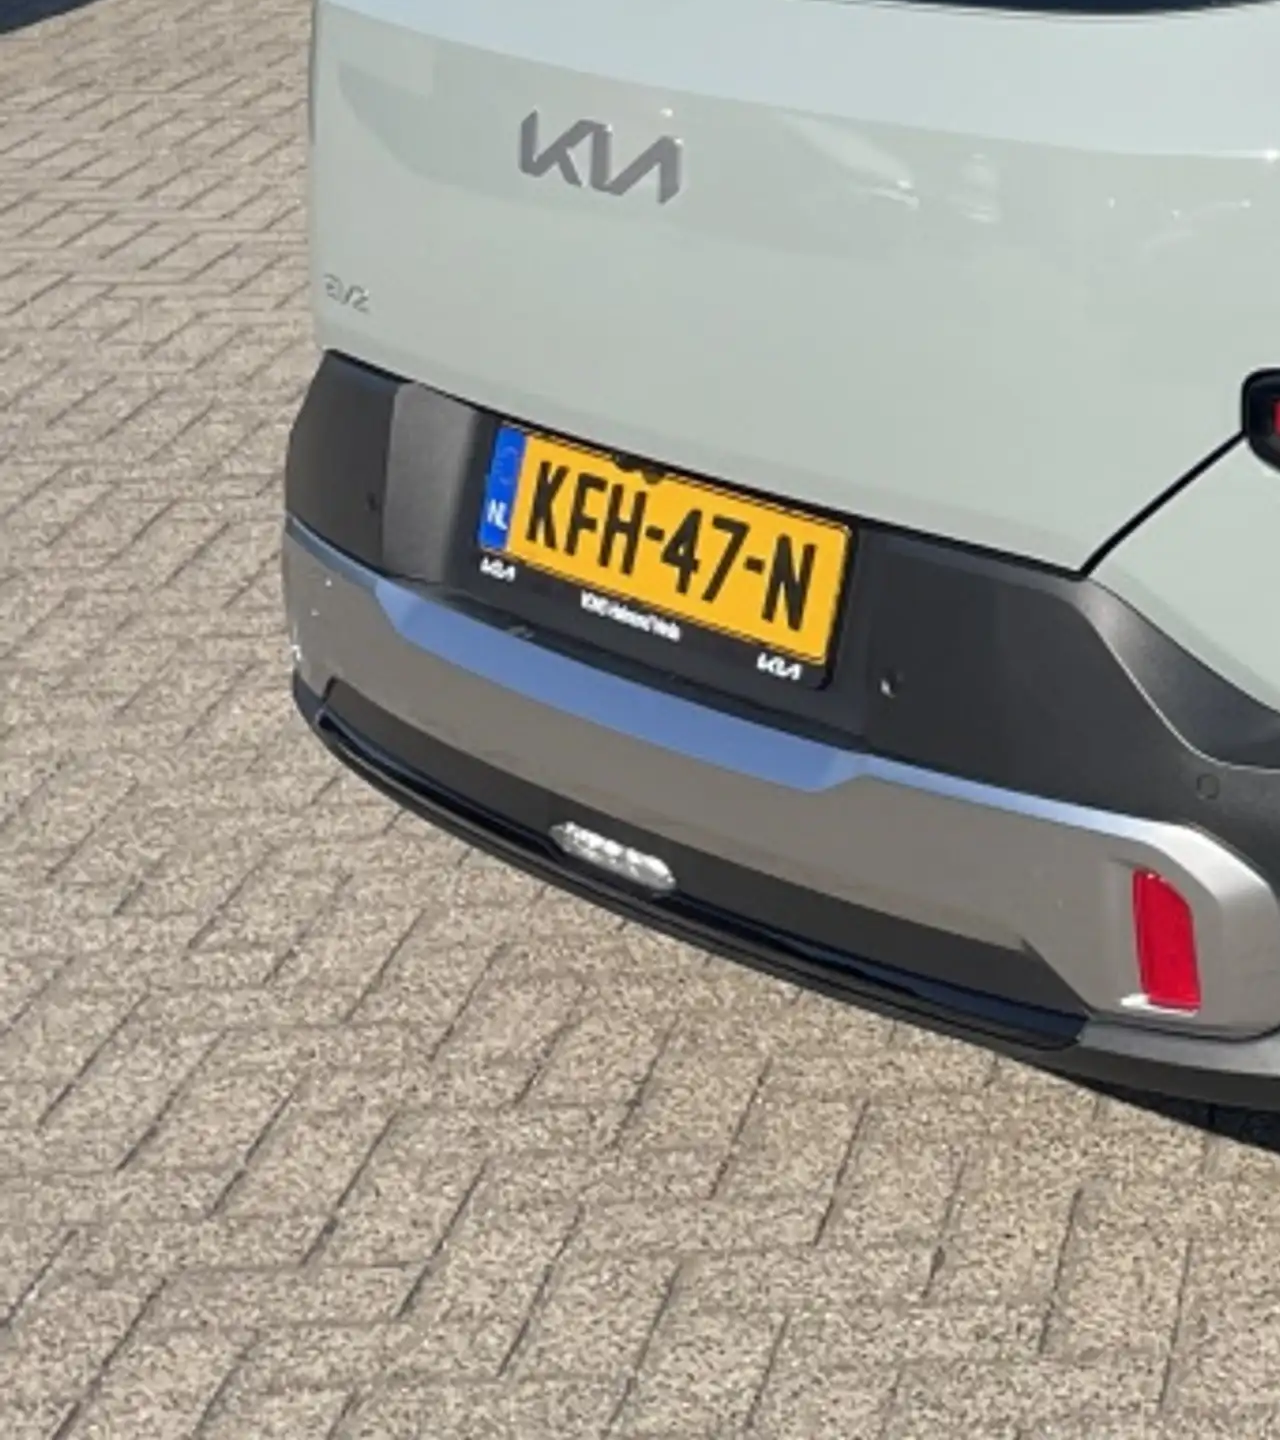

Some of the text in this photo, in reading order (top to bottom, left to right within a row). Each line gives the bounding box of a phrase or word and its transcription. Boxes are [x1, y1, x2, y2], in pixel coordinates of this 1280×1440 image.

[518, 106, 683, 205] KIA
[486, 499, 509, 531] NL
[525, 460, 818, 632] KFH-47-N
[757, 652, 803, 682] KIA
